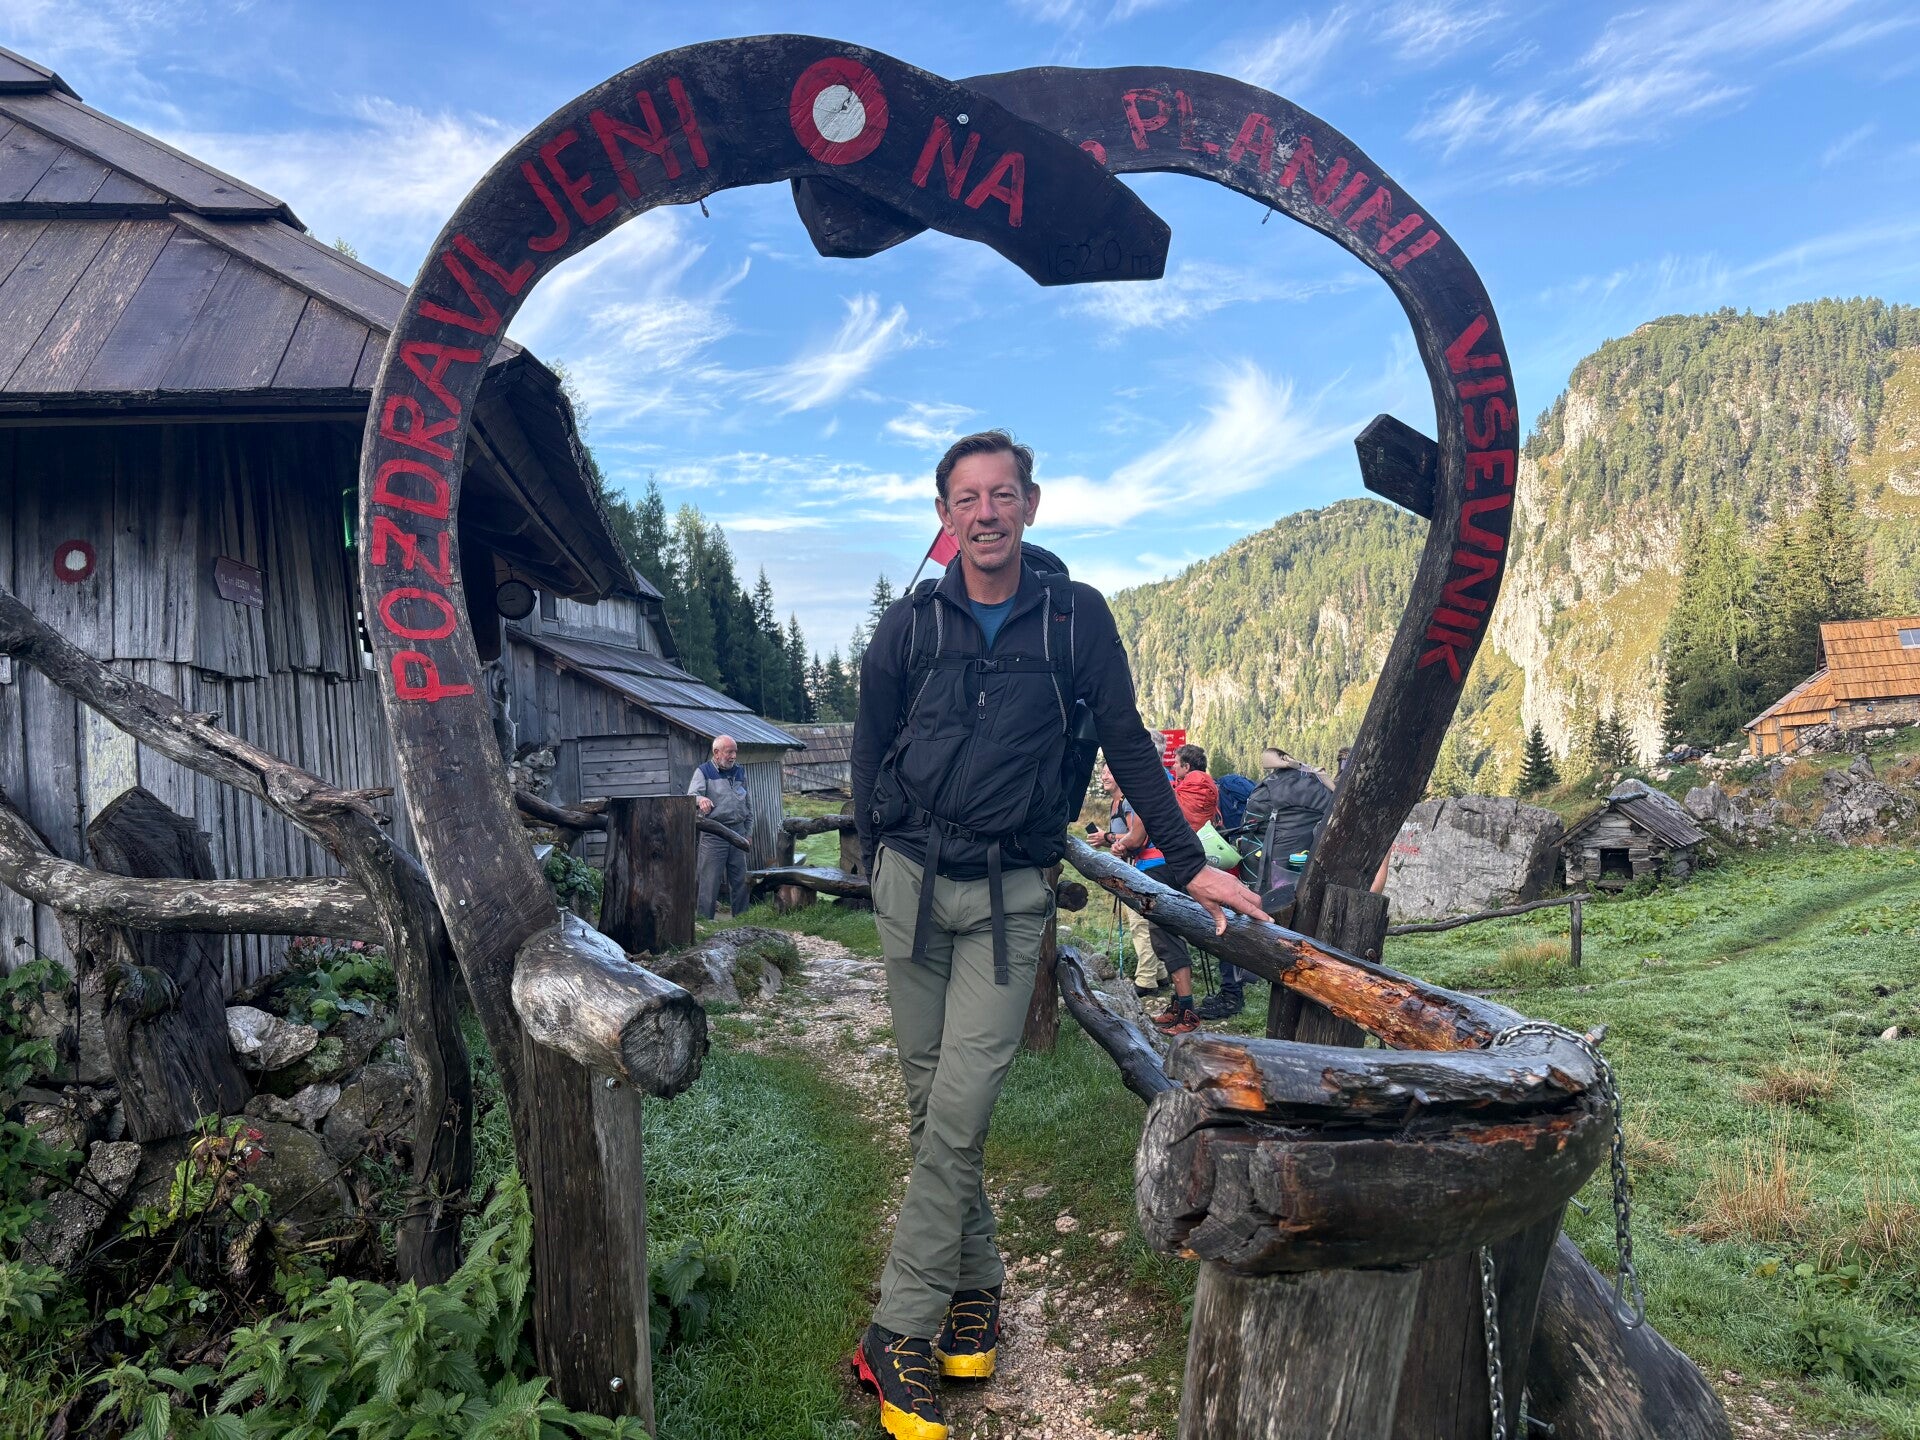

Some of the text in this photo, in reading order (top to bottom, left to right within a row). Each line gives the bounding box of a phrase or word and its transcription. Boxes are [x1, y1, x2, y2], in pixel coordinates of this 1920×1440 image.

[370, 76, 710, 702] POZDRAVLJENI
[911, 116, 1025, 228] NA
[1123, 88, 1440, 271] PLANINI
